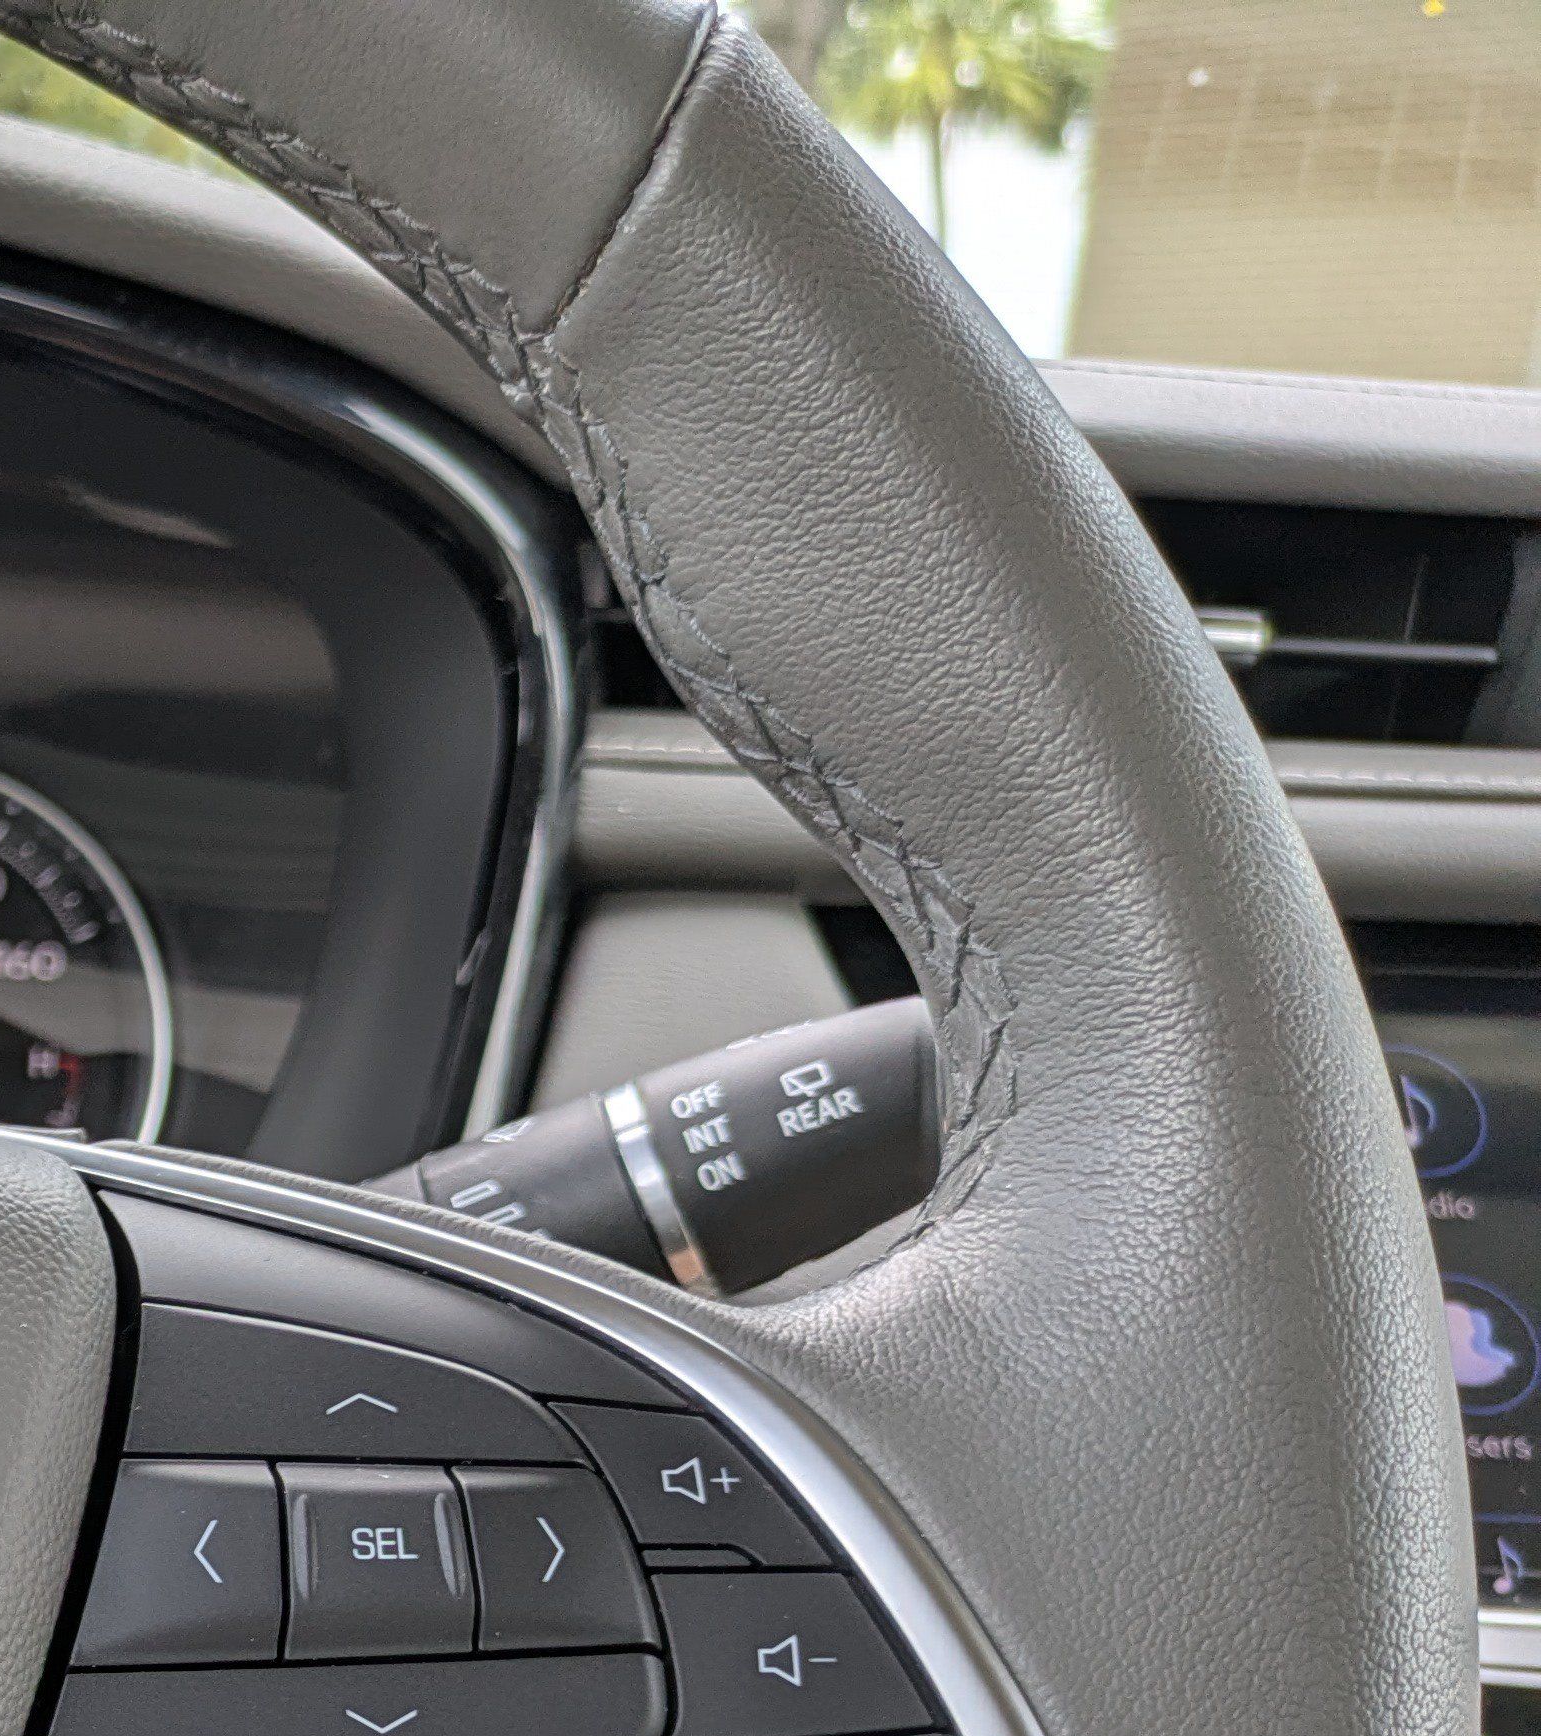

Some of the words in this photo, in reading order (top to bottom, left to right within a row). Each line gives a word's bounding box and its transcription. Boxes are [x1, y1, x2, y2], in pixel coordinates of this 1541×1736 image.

[670, 1080, 723, 1120] OFF
[776, 1089, 864, 1138] REAR
[681, 1114, 732, 1155] INT
[697, 1153, 747, 1191] ON
[1425, 1192, 1475, 1221] dio
[1466, 1434, 1532, 1460] sers
[351, 1526, 419, 1562] SEL
